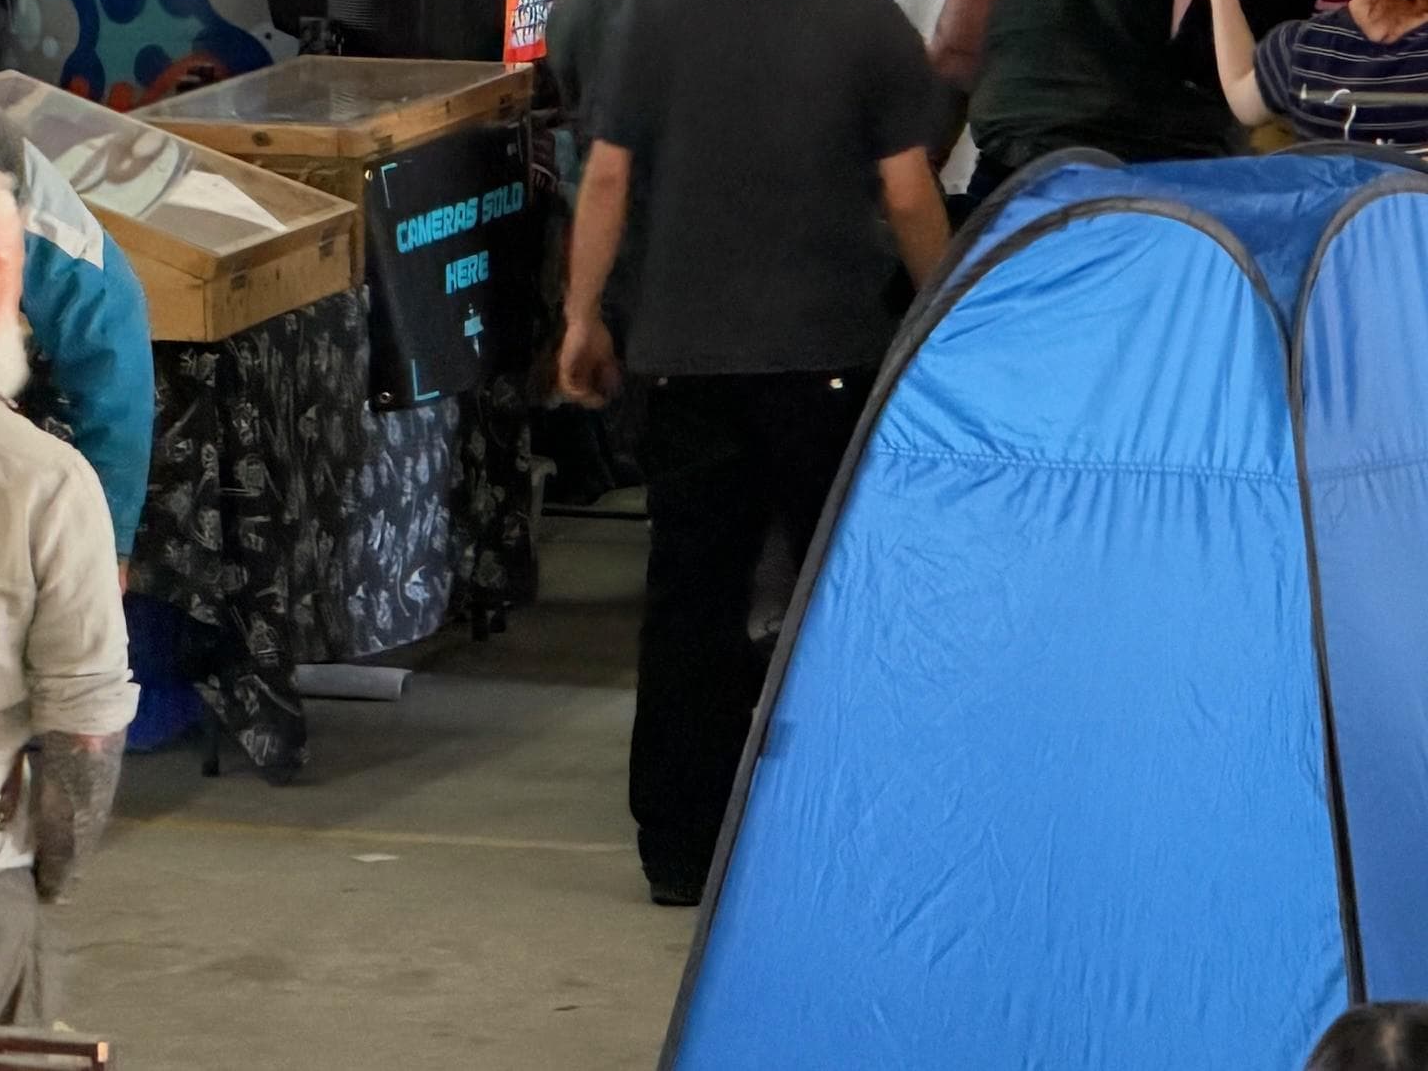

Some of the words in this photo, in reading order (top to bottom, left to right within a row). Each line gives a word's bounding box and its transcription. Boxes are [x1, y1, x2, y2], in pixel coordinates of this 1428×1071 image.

[396, 197, 478, 254] CAMERAS
[482, 181, 524, 224] SOLD
[445, 250, 489, 295] HERE
